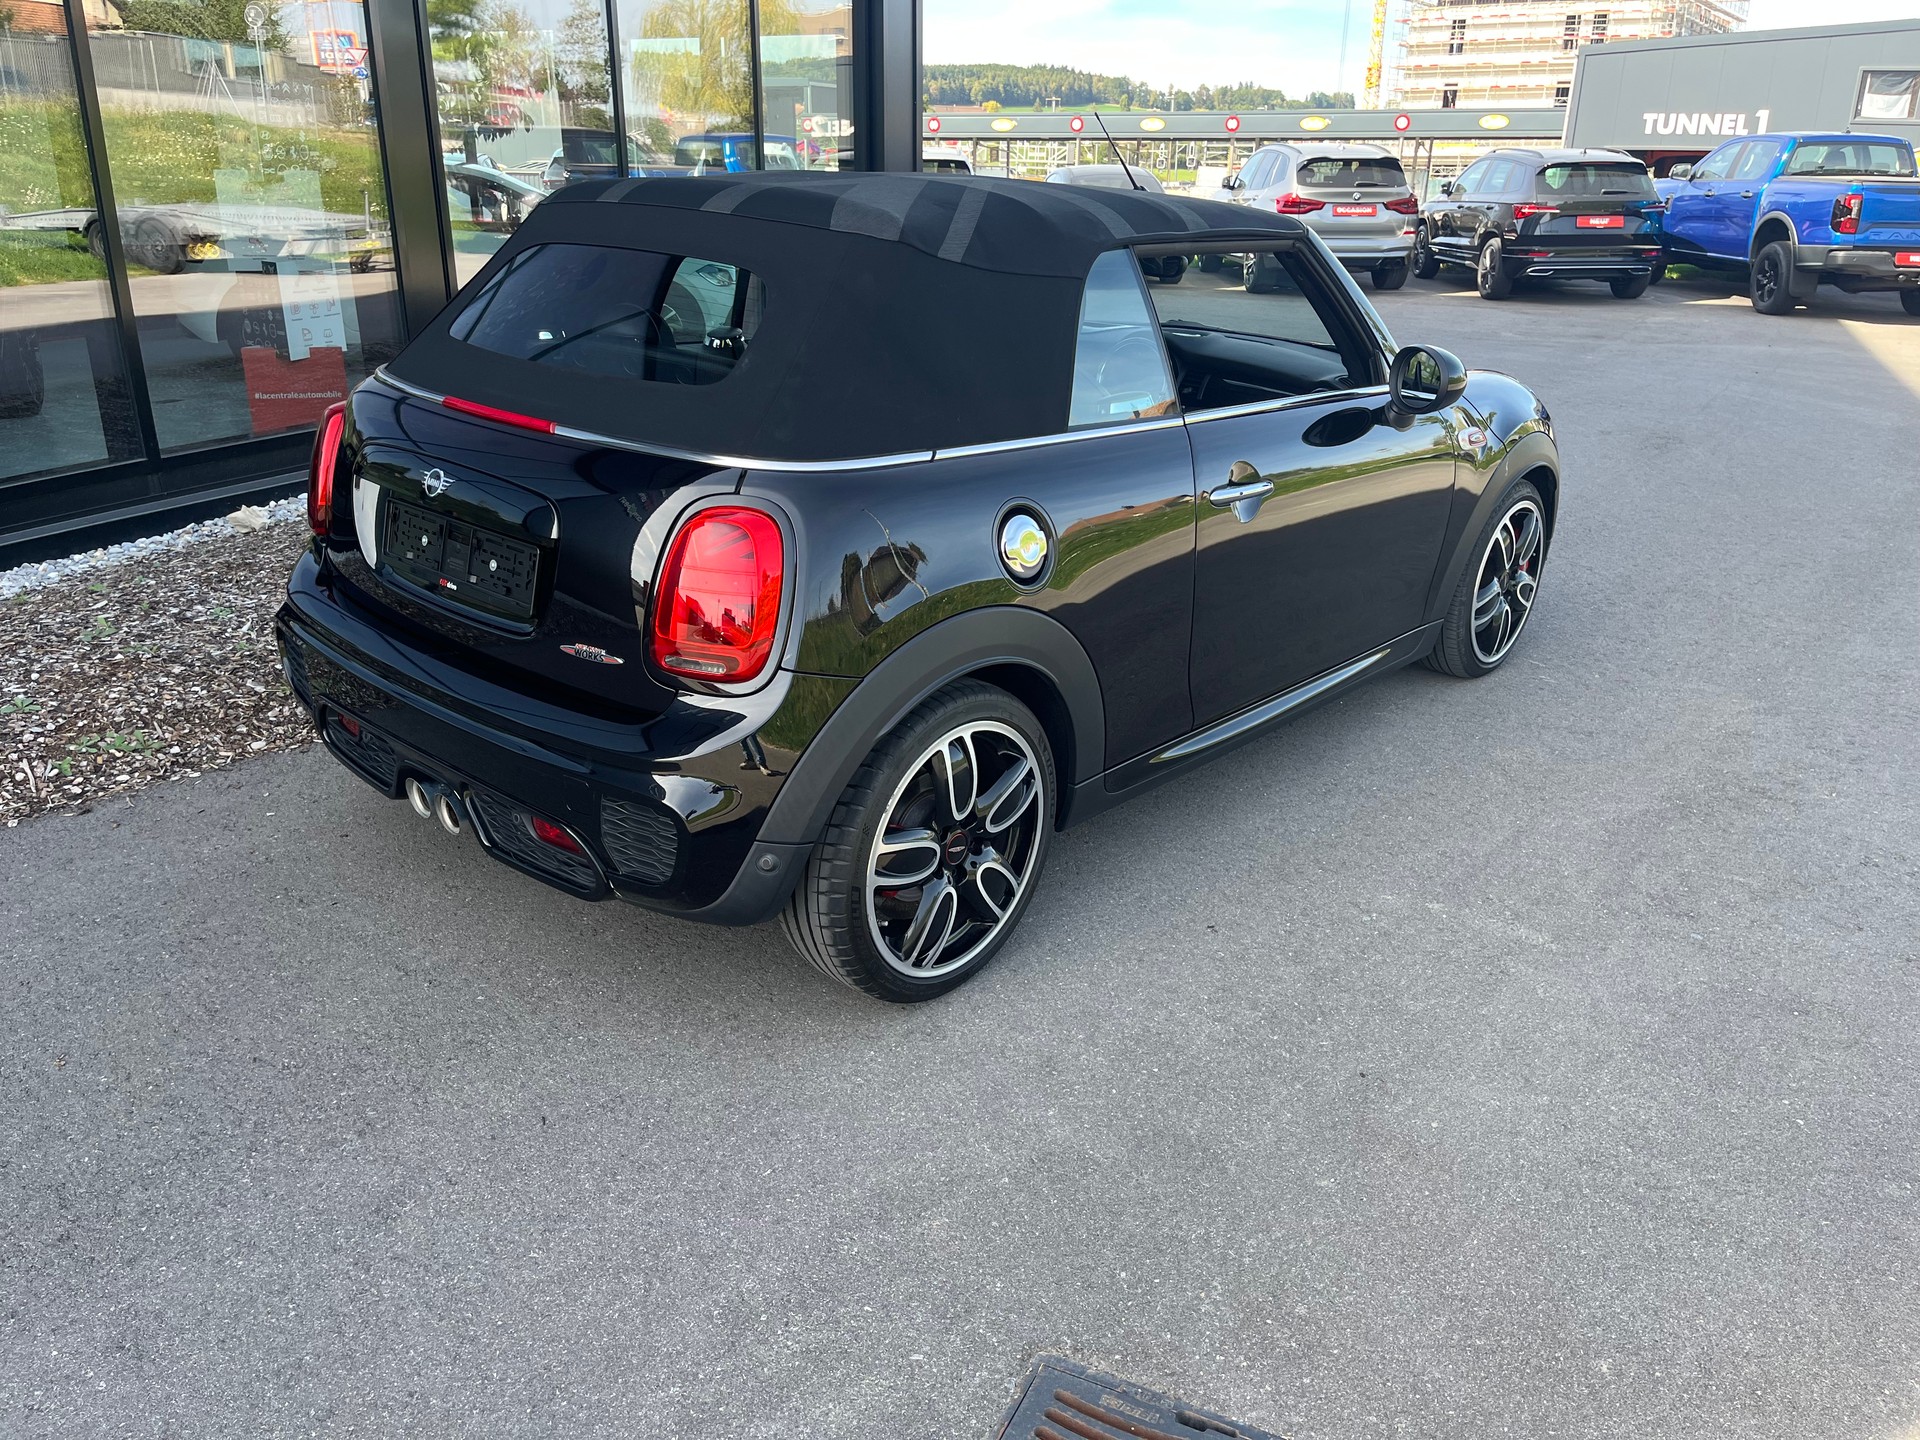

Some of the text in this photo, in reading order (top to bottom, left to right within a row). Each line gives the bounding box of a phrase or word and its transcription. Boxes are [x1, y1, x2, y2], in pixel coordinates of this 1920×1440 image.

[1643, 109, 1769, 135] TUNNEL 1
[1589, 217, 1610, 225] NEUF
[255, 390, 342, 400] #lacentraleautomobile
[575, 649, 604, 662] WORKS
